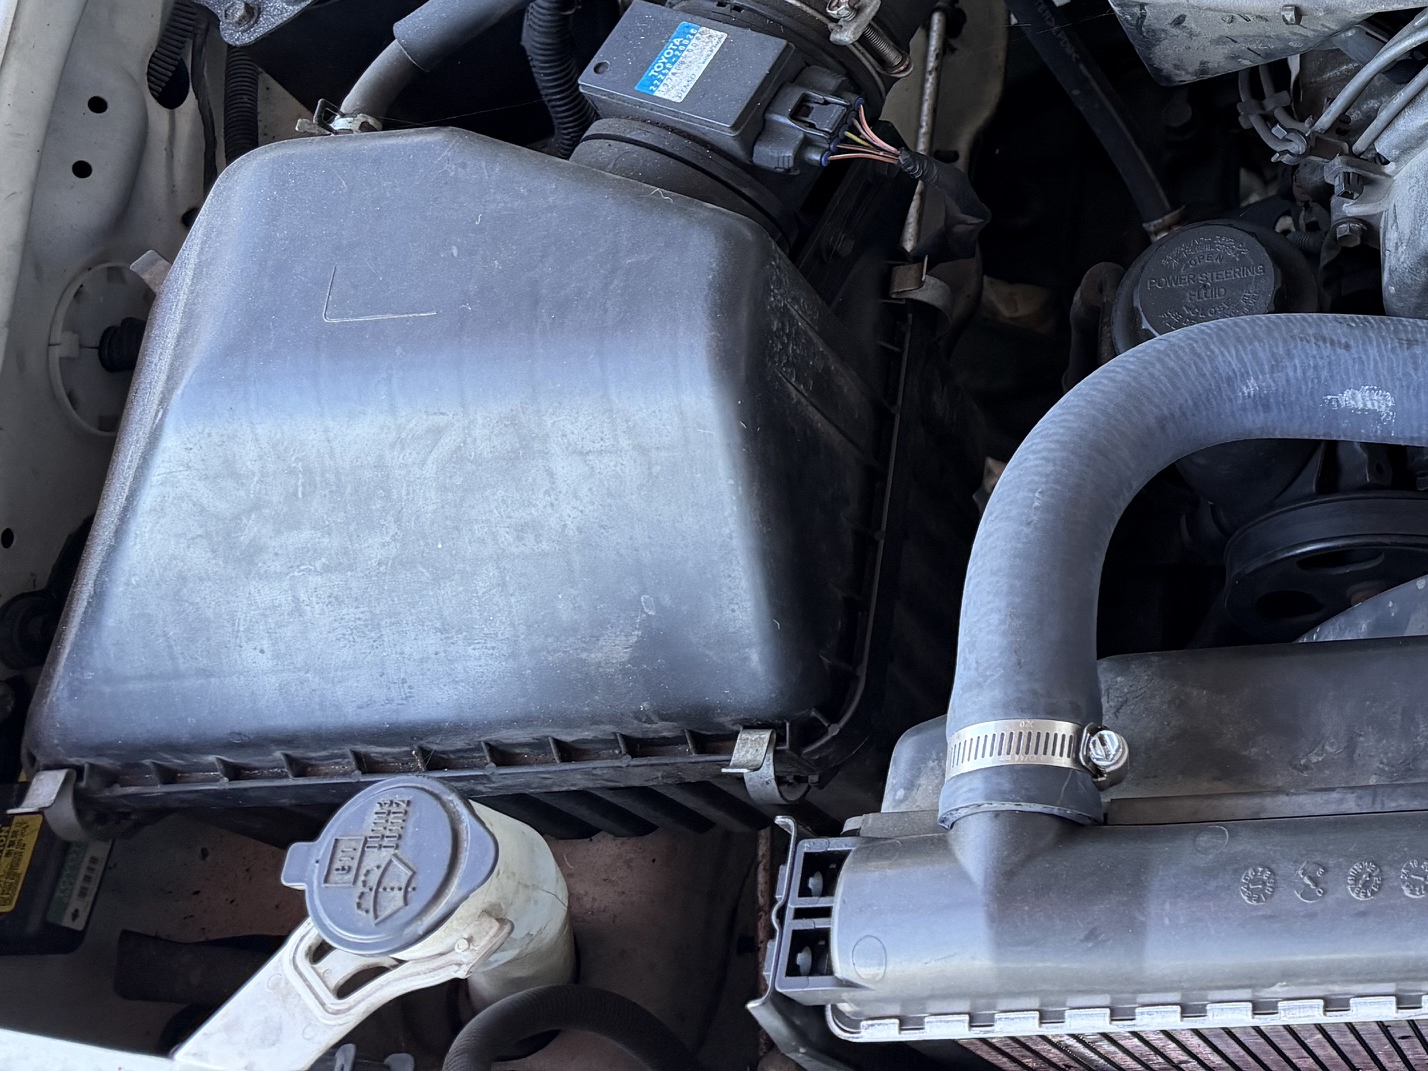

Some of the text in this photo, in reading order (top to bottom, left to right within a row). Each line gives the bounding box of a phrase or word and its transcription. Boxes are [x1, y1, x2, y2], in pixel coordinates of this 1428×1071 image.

[648, 37, 684, 76] TOYOTA
[1189, 253, 1224, 268] OPEN
[1147, 265, 1266, 290] POWER STEERING
[1188, 287, 1227, 302] FLUID
